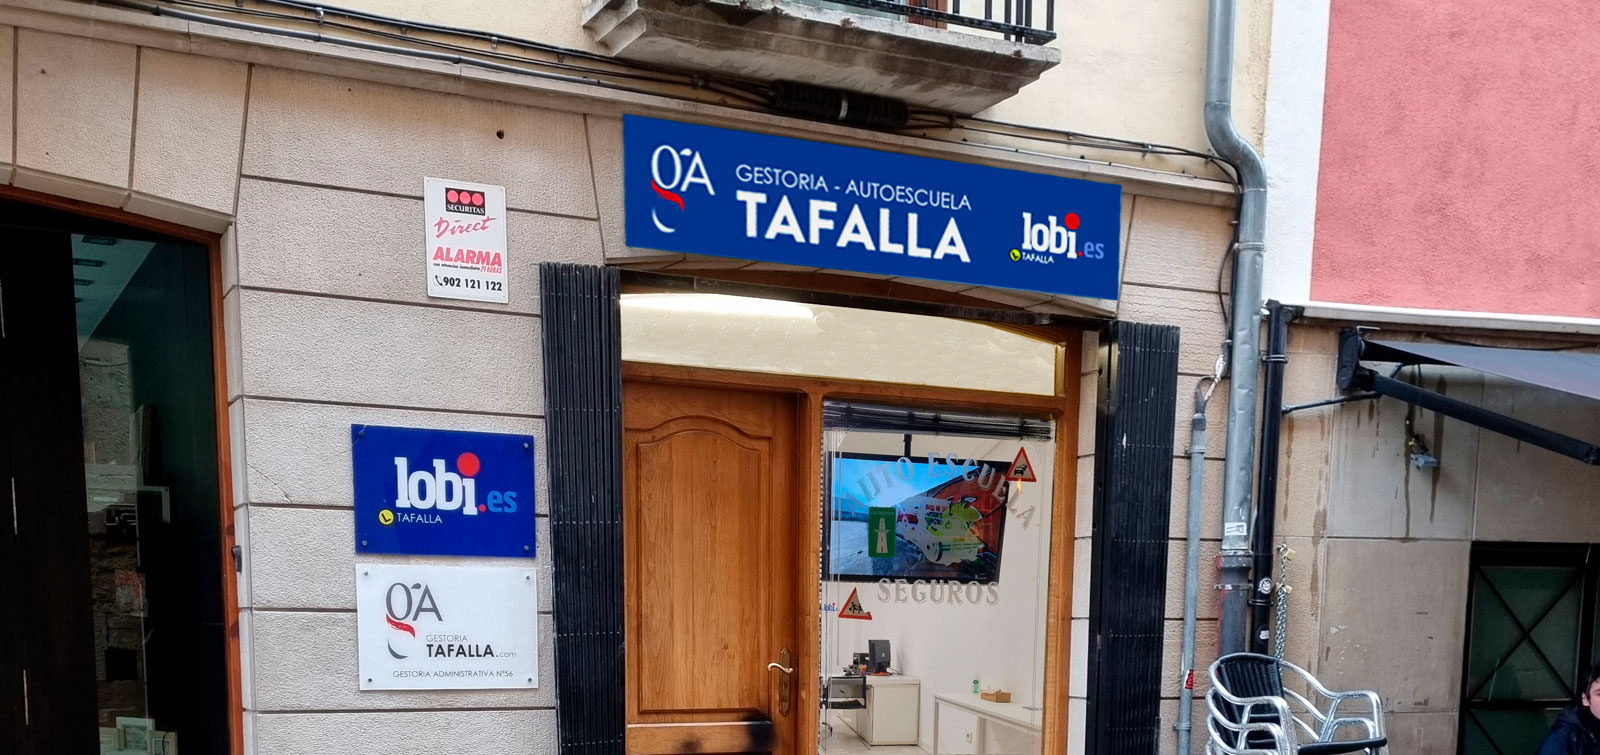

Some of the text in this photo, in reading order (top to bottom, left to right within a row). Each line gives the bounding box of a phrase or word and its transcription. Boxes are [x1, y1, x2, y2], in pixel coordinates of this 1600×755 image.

[735, 163, 829, 193] GESTORIA
[845, 179, 972, 211] AUTOESCUELA
[446, 204, 485, 214] SECURITAS
[434, 216, 497, 239] Direct
[736, 190, 971, 264] TAFALLA
[433, 246, 502, 267] ALARMA
[1022, 251, 1055, 264] TAFALLA
[443, 276, 502, 291] 902 121 122
[397, 512, 443, 524] TAFALLA
[877, 578, 1000, 606] SEGUROS
[426, 634, 468, 643] GESTORIA
[392, 670, 431, 678] GESTORIA
[433, 670, 495, 678] ADMINISTRATIVA
